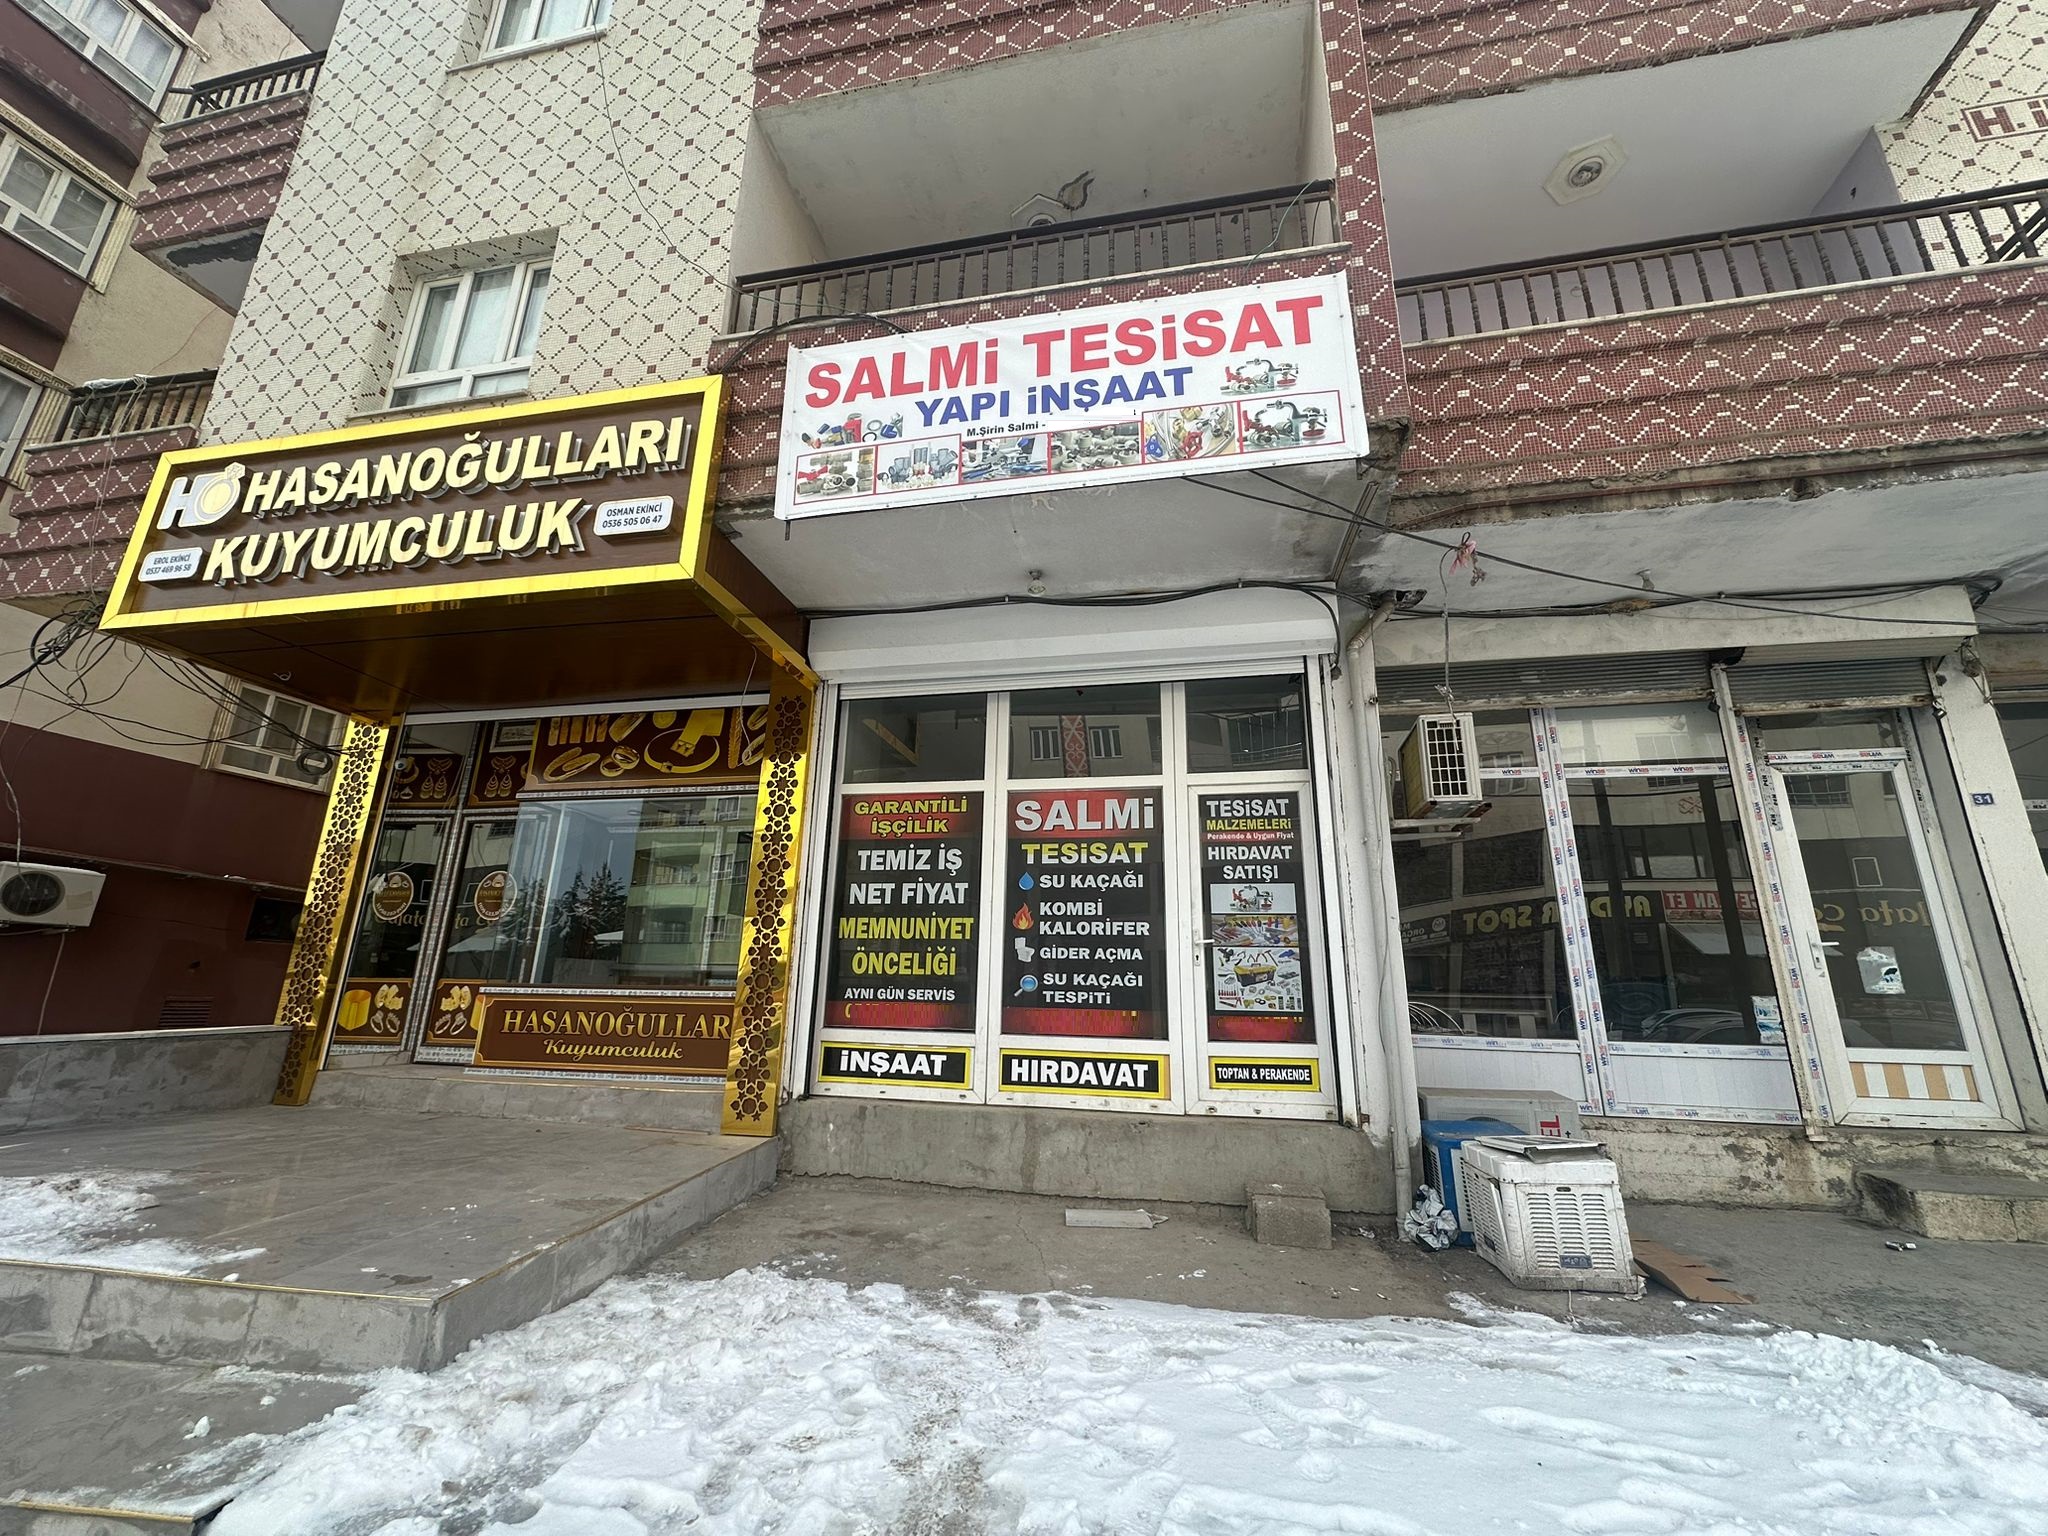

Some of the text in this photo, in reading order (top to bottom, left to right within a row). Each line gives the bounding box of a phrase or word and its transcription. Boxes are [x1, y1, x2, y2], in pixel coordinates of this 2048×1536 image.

[915, 391, 1009, 428] YAPI
[966, 421, 1040, 437] M.Şirin Salmi
[241, 416, 687, 516] HASANOĞULLARI
[606, 502, 663, 517] OSMAN EKİNCİ
[602, 515, 663, 528] 0536 505 06 47
[202, 498, 589, 583] KUYUMCULUK
[153, 553, 191, 565] EROL EKİNCİ
[854, 796, 968, 815] GARANTİLİ
[1974, 794, 1992, 804] 31
[871, 816, 949, 837] İŞÇİLİK
[1276, 832, 1295, 840] Fiyat
[858, 843, 963, 876] TEMİZ İŞ
[1207, 845, 1293, 860] HIRDAVAT
[1039, 870, 1144, 891] SU KAÇAĞI
[1223, 865, 1279, 882] SATIŞI
[849, 877, 969, 905] NET FİYAT
[1039, 899, 1102, 916] KOMBİ
[838, 911, 975, 940] MEMNUNİYET
[1039, 918, 1150, 936] KALORİFER
[852, 946, 957, 976] ÖNCELİĞİ
[1039, 945, 1143, 963] GİDER AÇMA
[1043, 972, 1143, 989] SU KAÇAĞI
[844, 986, 956, 1001] AYNI GÜN SERVİS
[543, 1038, 683, 1061] Kuyumculuk
[1011, 1059, 1148, 1088] HIRDAVAT
[1217, 1067, 1310, 1081] TOPTAN & PERAKENDE
